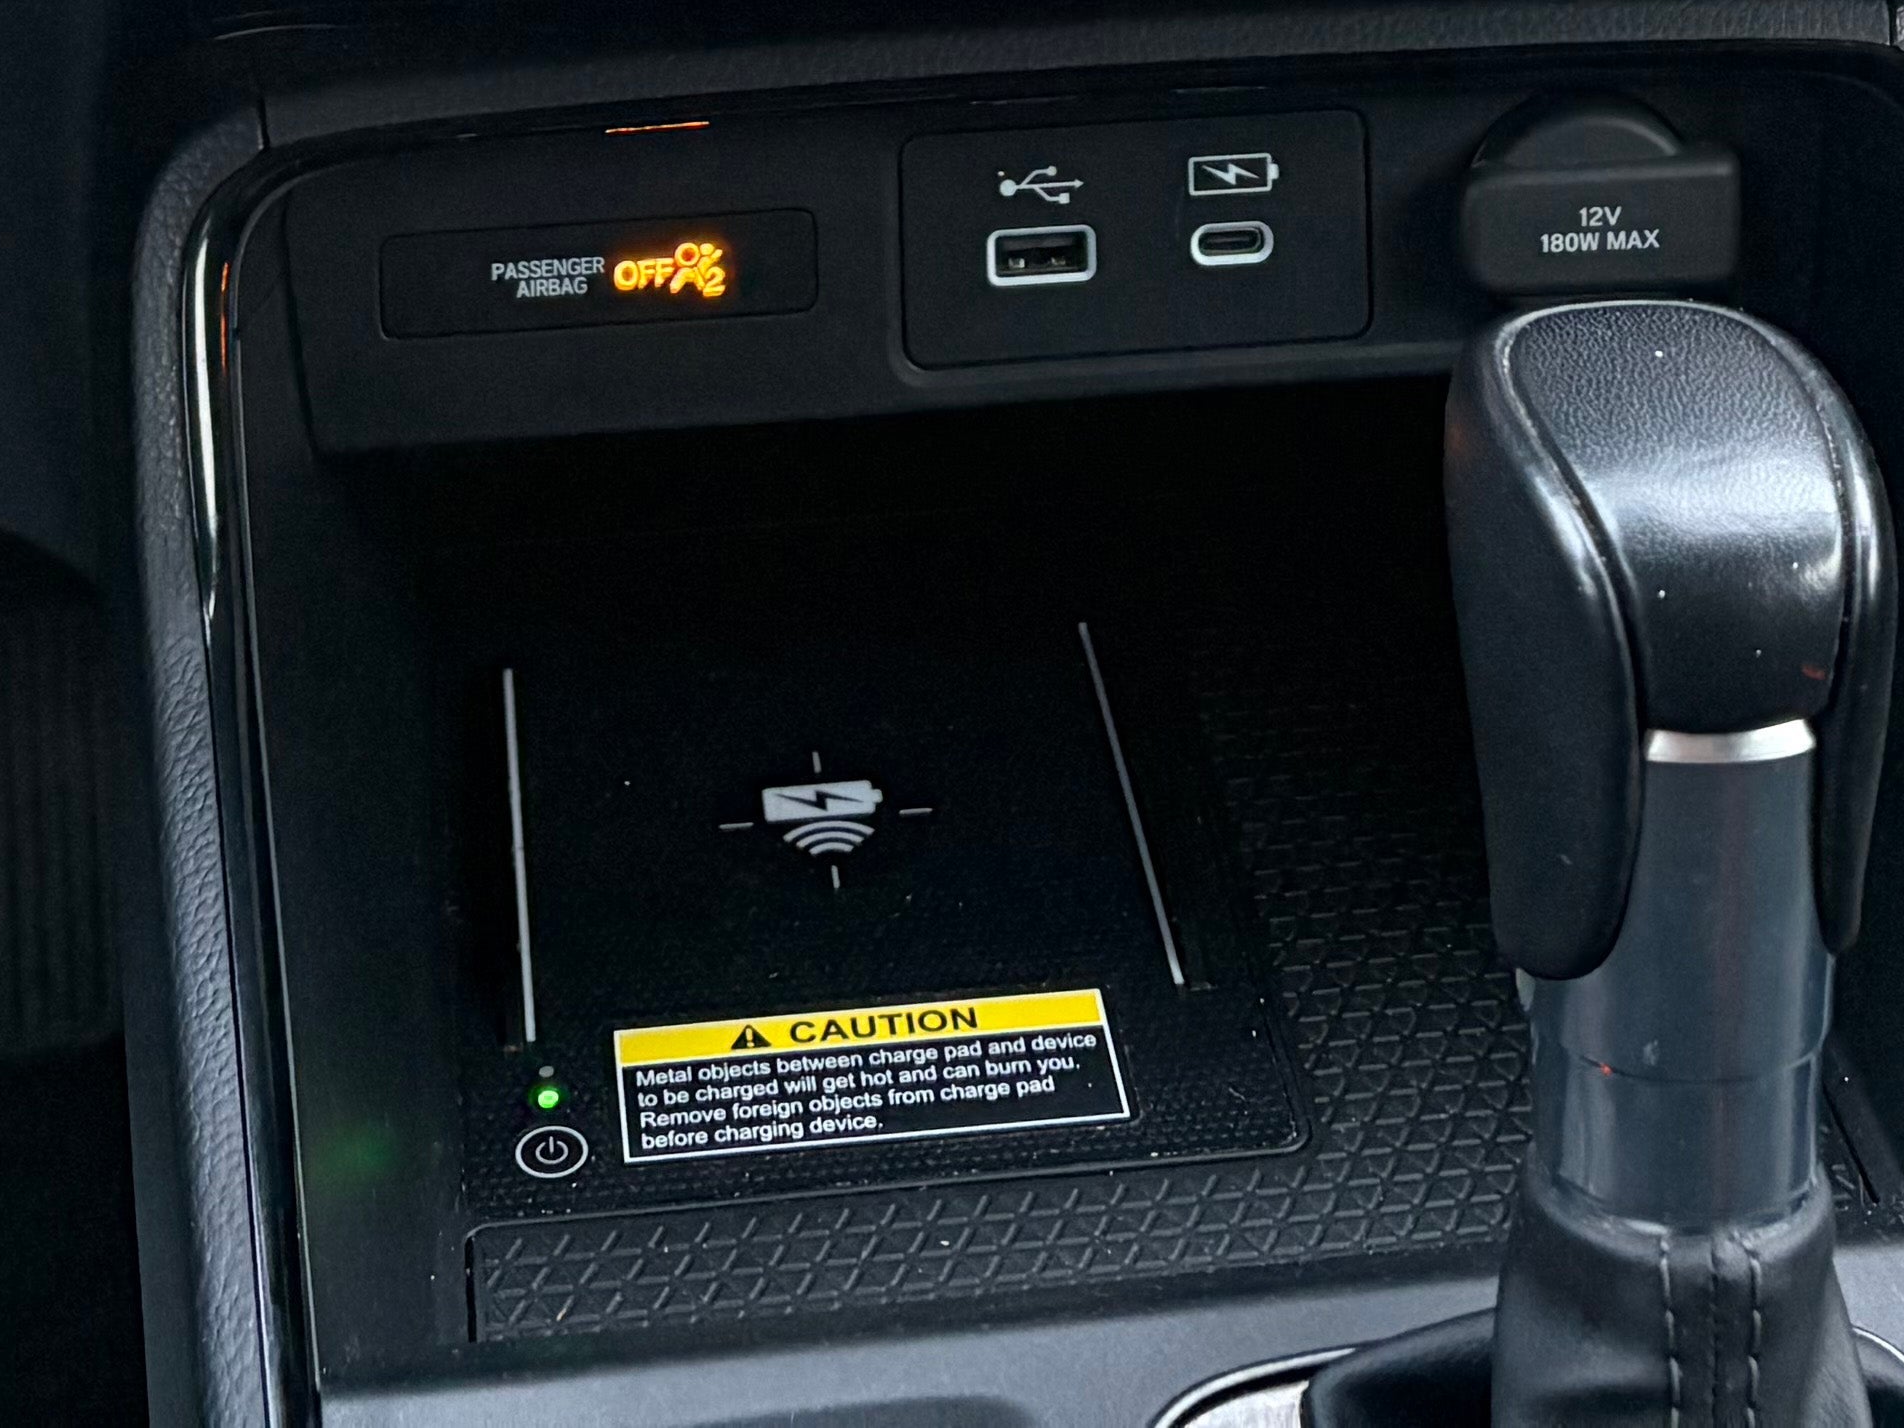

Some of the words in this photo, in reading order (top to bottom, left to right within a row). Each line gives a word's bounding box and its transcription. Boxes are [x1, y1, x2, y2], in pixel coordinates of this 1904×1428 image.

[1579, 206, 1622, 227] 12V
[1540, 232, 1600, 253] 180W
[1606, 228, 1660, 251] MAX
[491, 257, 606, 281] PASSENGER
[613, 258, 674, 290] OFF
[516, 277, 588, 298] AIRBAG
[790, 1007, 978, 1044] CAUTION
[635, 1066, 693, 1087] Metal
[698, 1060, 771, 1082] objects
[776, 1052, 863, 1074] between
[868, 1048, 938, 1066] charge
[944, 1040, 982, 1062] pad
[988, 1036, 1026, 1055] and
[1031, 1032, 1097, 1051] device
[637, 1092, 658, 1107] to
[663, 1089, 689, 1106] be
[695, 1079, 779, 1101] charged
[784, 1075, 817, 1094] will
[822, 1073, 856, 1094] get
[860, 1070, 894, 1087] hot
[899, 1066, 937, 1084] and
[942, 1064, 980, 1079] can
[985, 1059, 1031, 1076] burn
[1037, 1056, 1080, 1075] you.
[640, 1107, 726, 1128] Remove
[732, 1099, 804, 1120] foreign
[808, 1092, 883, 1115] objects
[888, 1086, 934, 1105] from
[940, 1083, 1010, 1101] charge
[1016, 1075, 1055, 1097] pad
[641, 1130, 708, 1150] before
[714, 1120, 804, 1142] charging
[809, 1114, 883, 1134] device.
